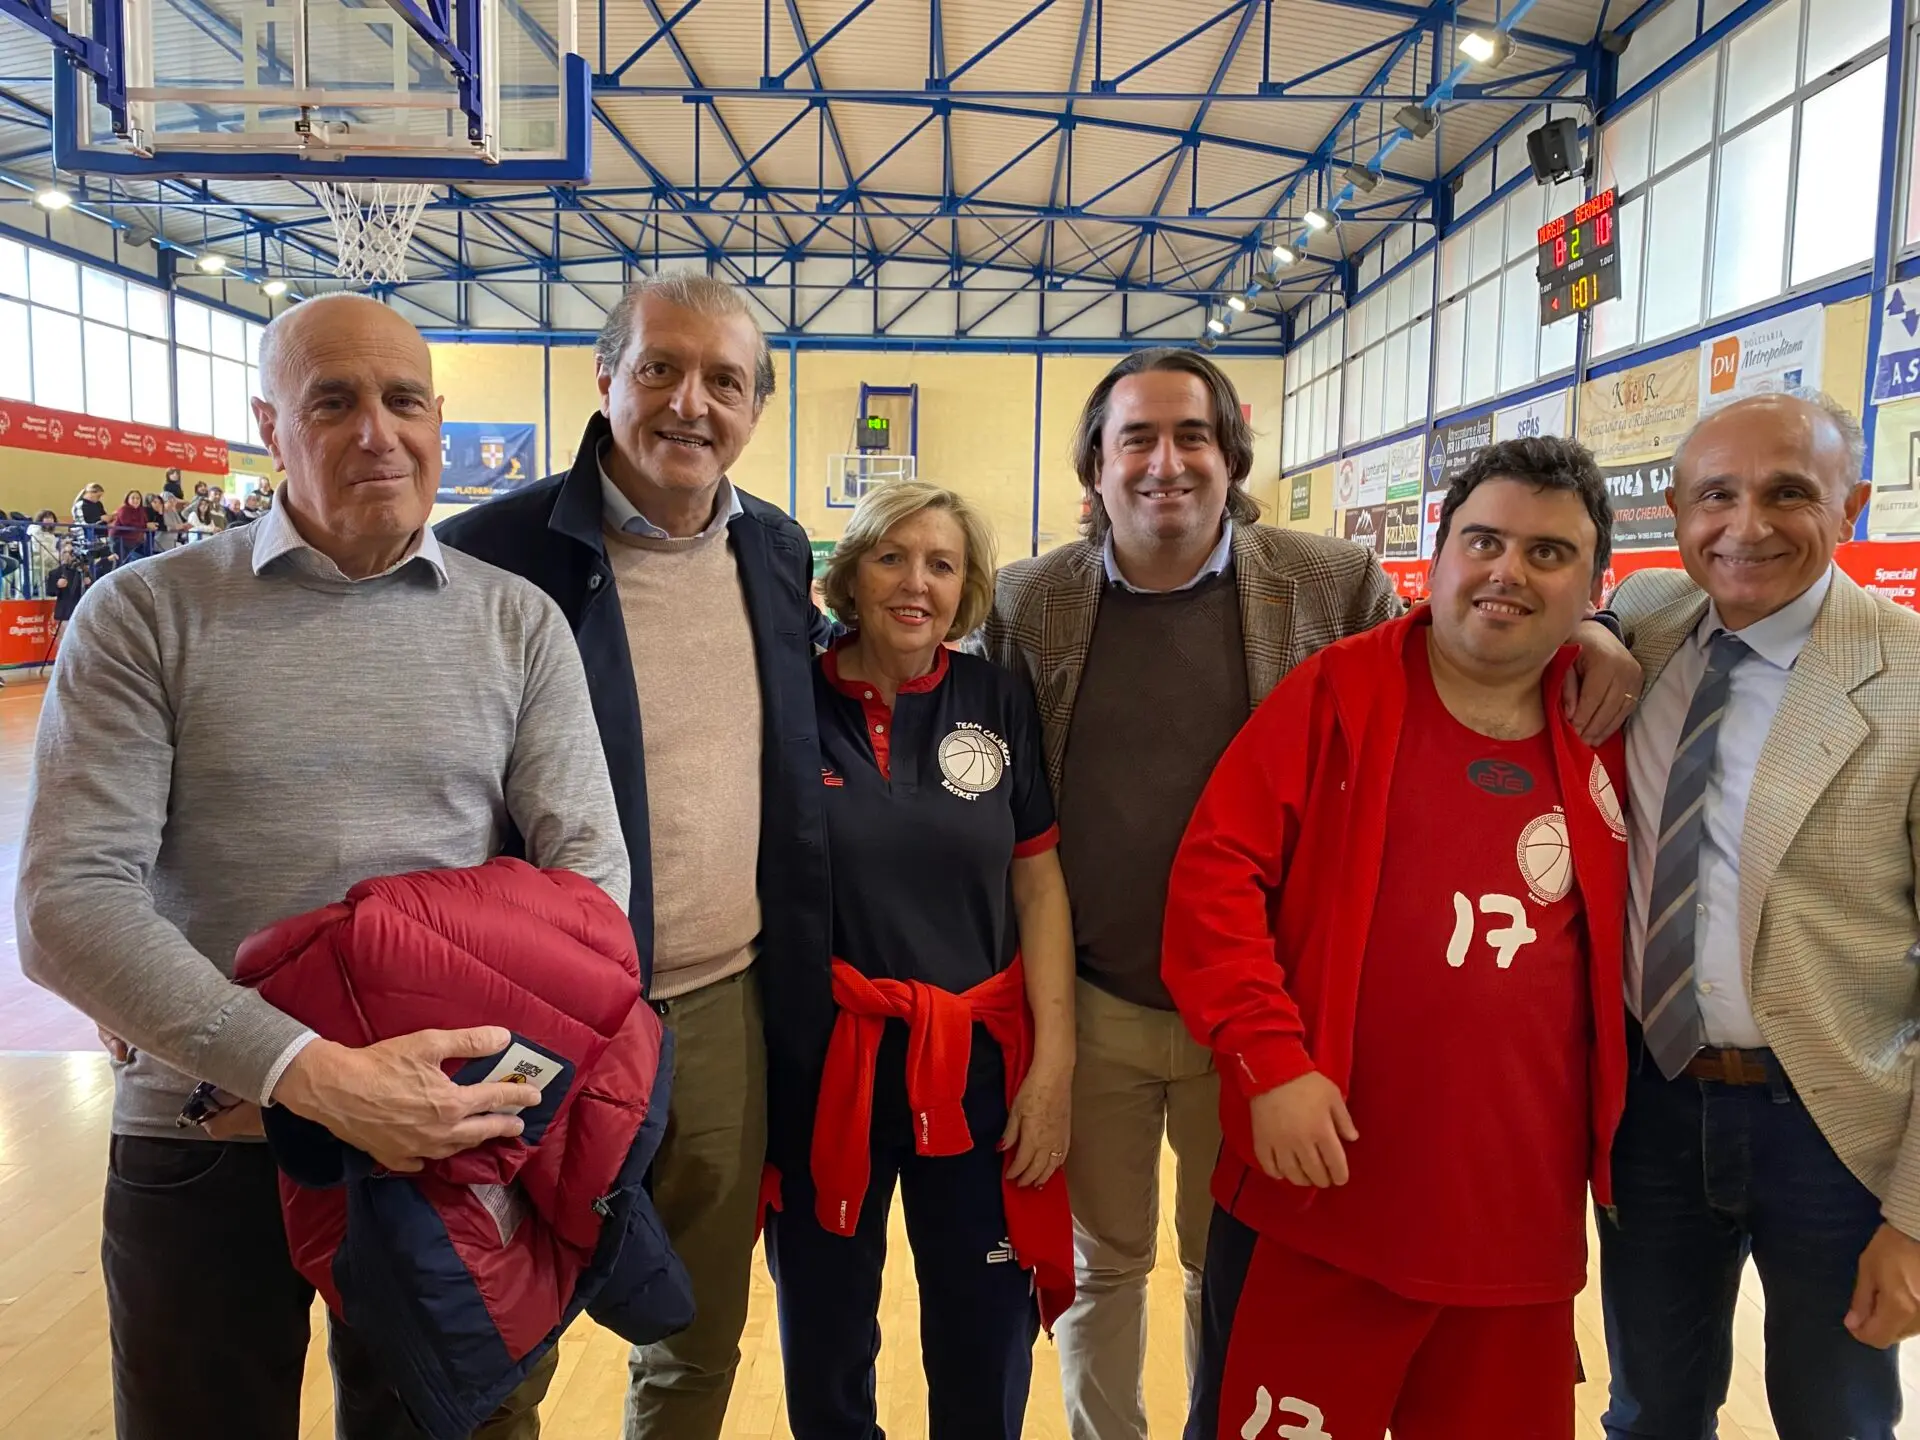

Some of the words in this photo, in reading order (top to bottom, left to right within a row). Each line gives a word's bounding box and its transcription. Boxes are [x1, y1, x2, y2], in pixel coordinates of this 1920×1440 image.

[1539, 217, 1566, 245] MURGIA
[1575, 190, 1614, 225] BERNALDA
[1595, 212, 1609, 246] 10
[1555, 237, 1565, 267] 8
[1571, 228, 1580, 259] 2
[1568, 258, 1584, 271] PERIOD
[1572, 273, 1597, 309] 1:01
[1741, 337, 1803, 370] Metropolitana
[1744, 329, 1784, 349] DOLCIARIA
[1713, 353, 1736, 378] DM
[1517, 416, 1540, 437] SEPAS
[1605, 468, 1644, 497] TTICA
[1875, 568, 1918, 583] Special
[16, 615, 45, 625] Special
[955, 721, 982, 731] TEAM
[982, 729, 1011, 767] CALABRIA
[940, 779, 980, 802] BASKET
[1528, 892, 1550, 908] BASKET
[1446, 891, 1538, 969] 17
